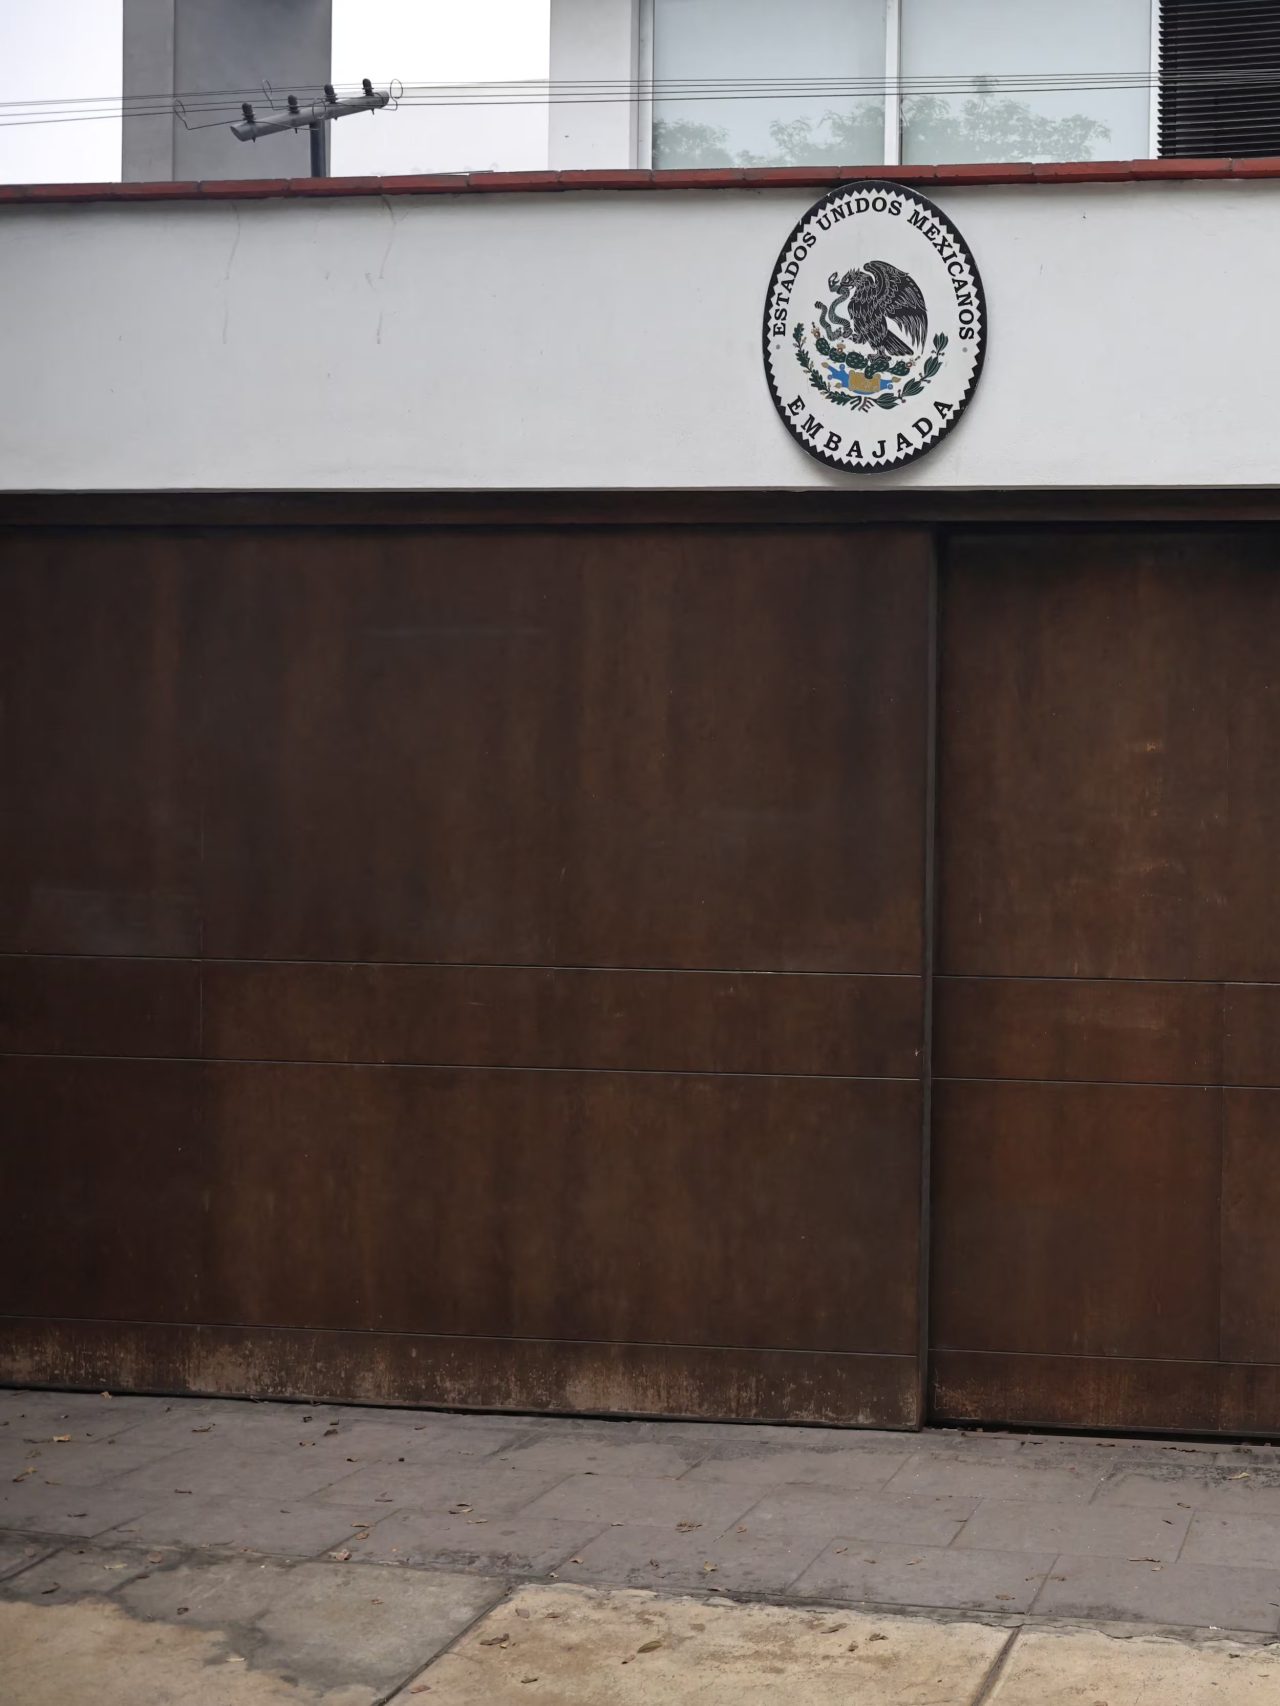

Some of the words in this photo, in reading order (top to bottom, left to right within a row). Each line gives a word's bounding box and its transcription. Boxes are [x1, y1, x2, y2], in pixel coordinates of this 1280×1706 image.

[773, 231, 818, 337] ESTADOS
[816, 196, 903, 231] UNIDOS
[907, 209, 975, 341] MEXICANOS
[786, 394, 954, 459] EMBAJADA
